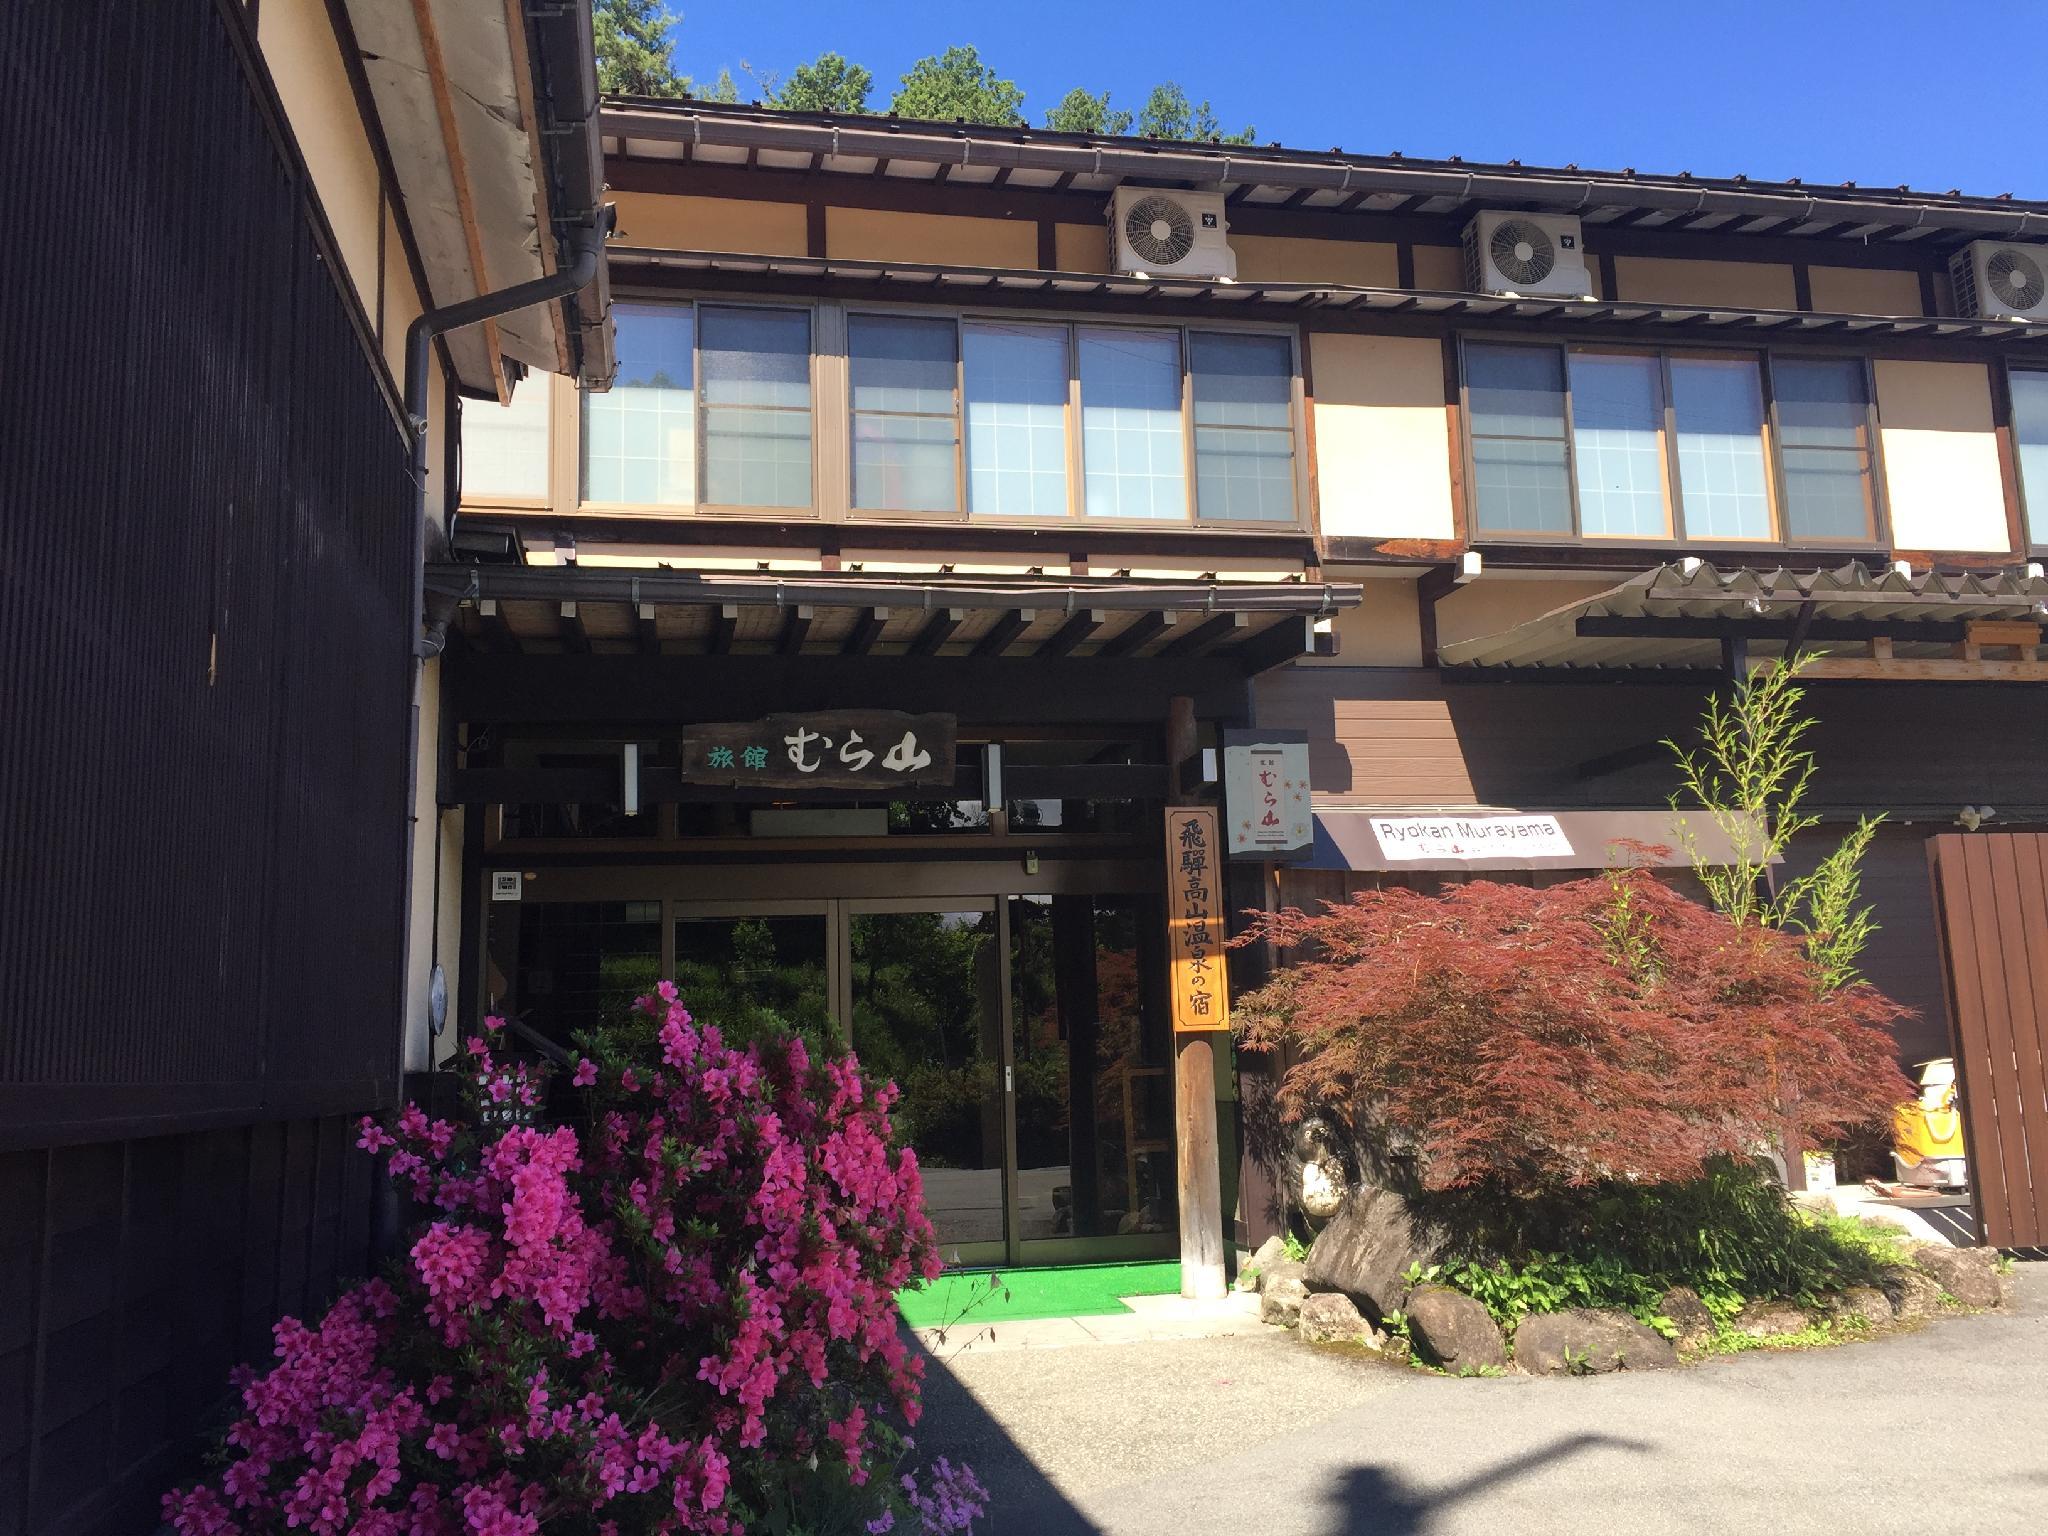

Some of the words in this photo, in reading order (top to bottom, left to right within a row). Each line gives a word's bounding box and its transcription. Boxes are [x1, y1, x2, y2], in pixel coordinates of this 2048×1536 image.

[707, 745, 769, 771] 旅館
[783, 726, 932, 773] むら山
[1258, 770, 1280, 827] むら山
[1379, 822, 1454, 842] Ryokan
[1456, 822, 1556, 839] Murayama
